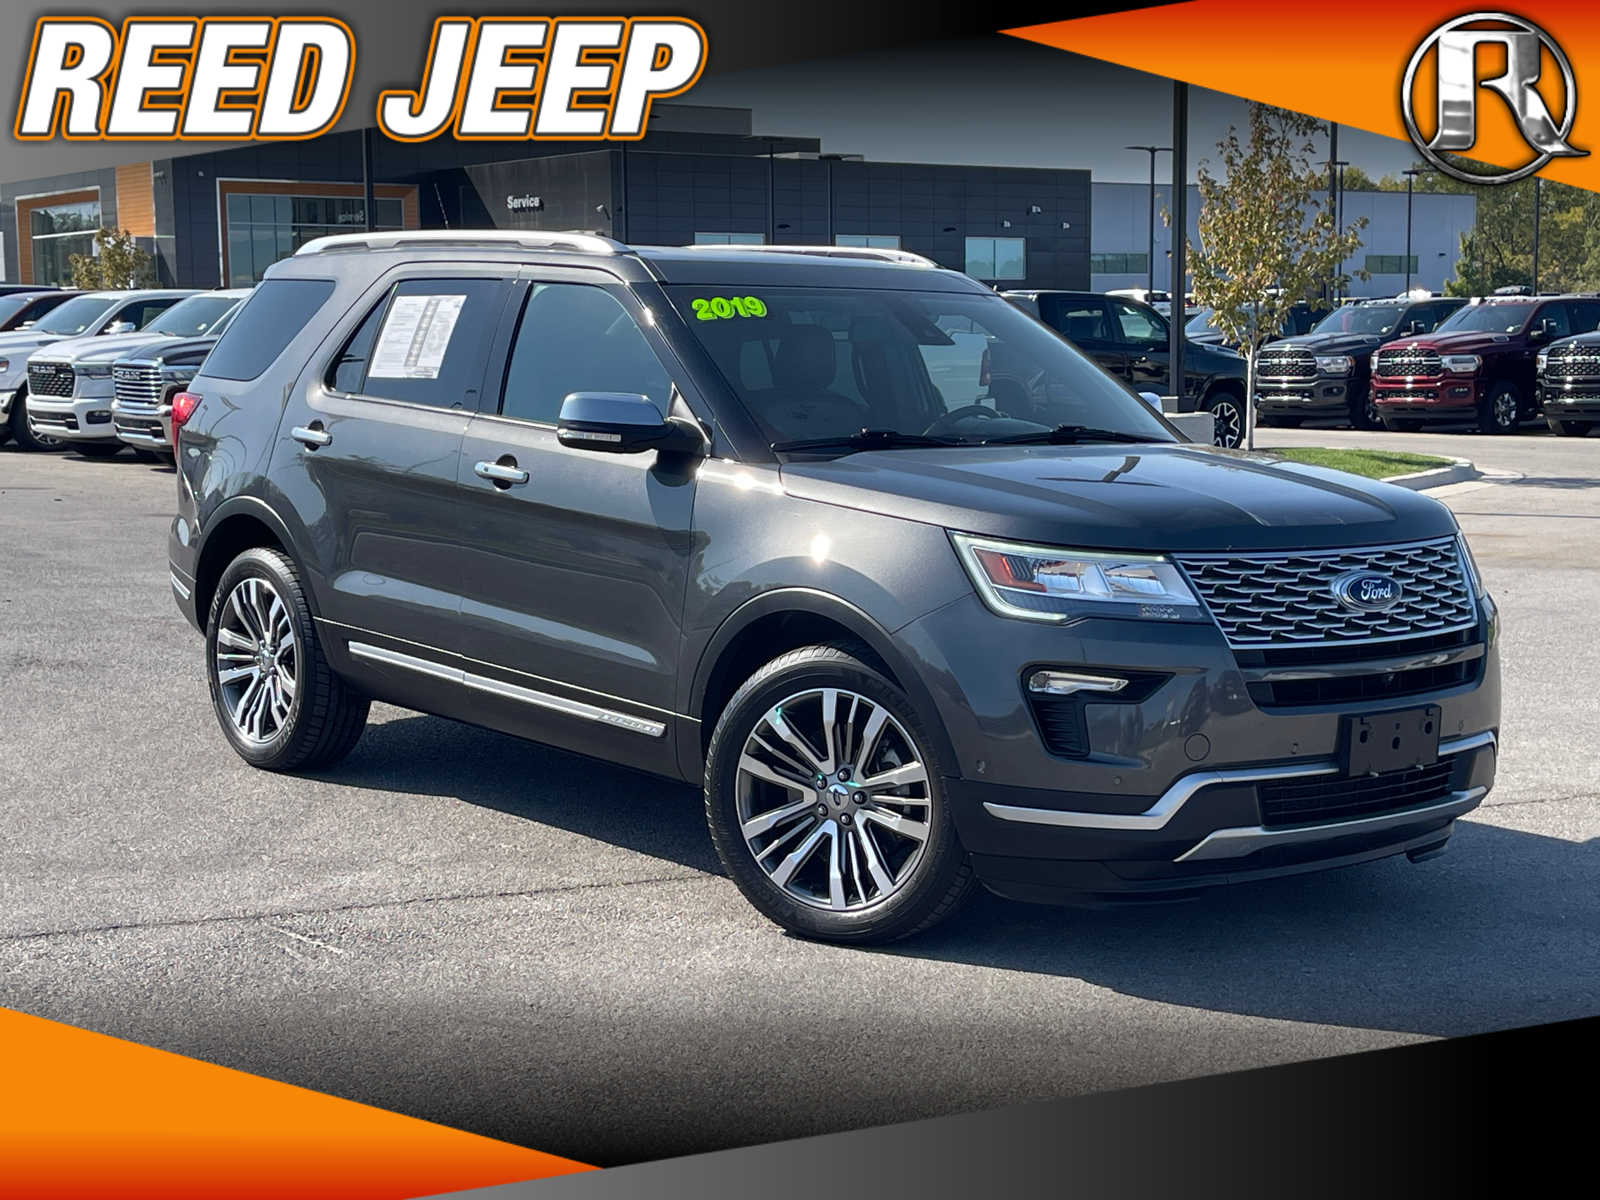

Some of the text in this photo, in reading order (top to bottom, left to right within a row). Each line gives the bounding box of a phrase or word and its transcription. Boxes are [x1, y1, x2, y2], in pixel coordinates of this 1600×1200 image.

[506, 194, 541, 209] Service
[691, 296, 768, 320] 2019
[1360, 579, 1393, 601] Ford
